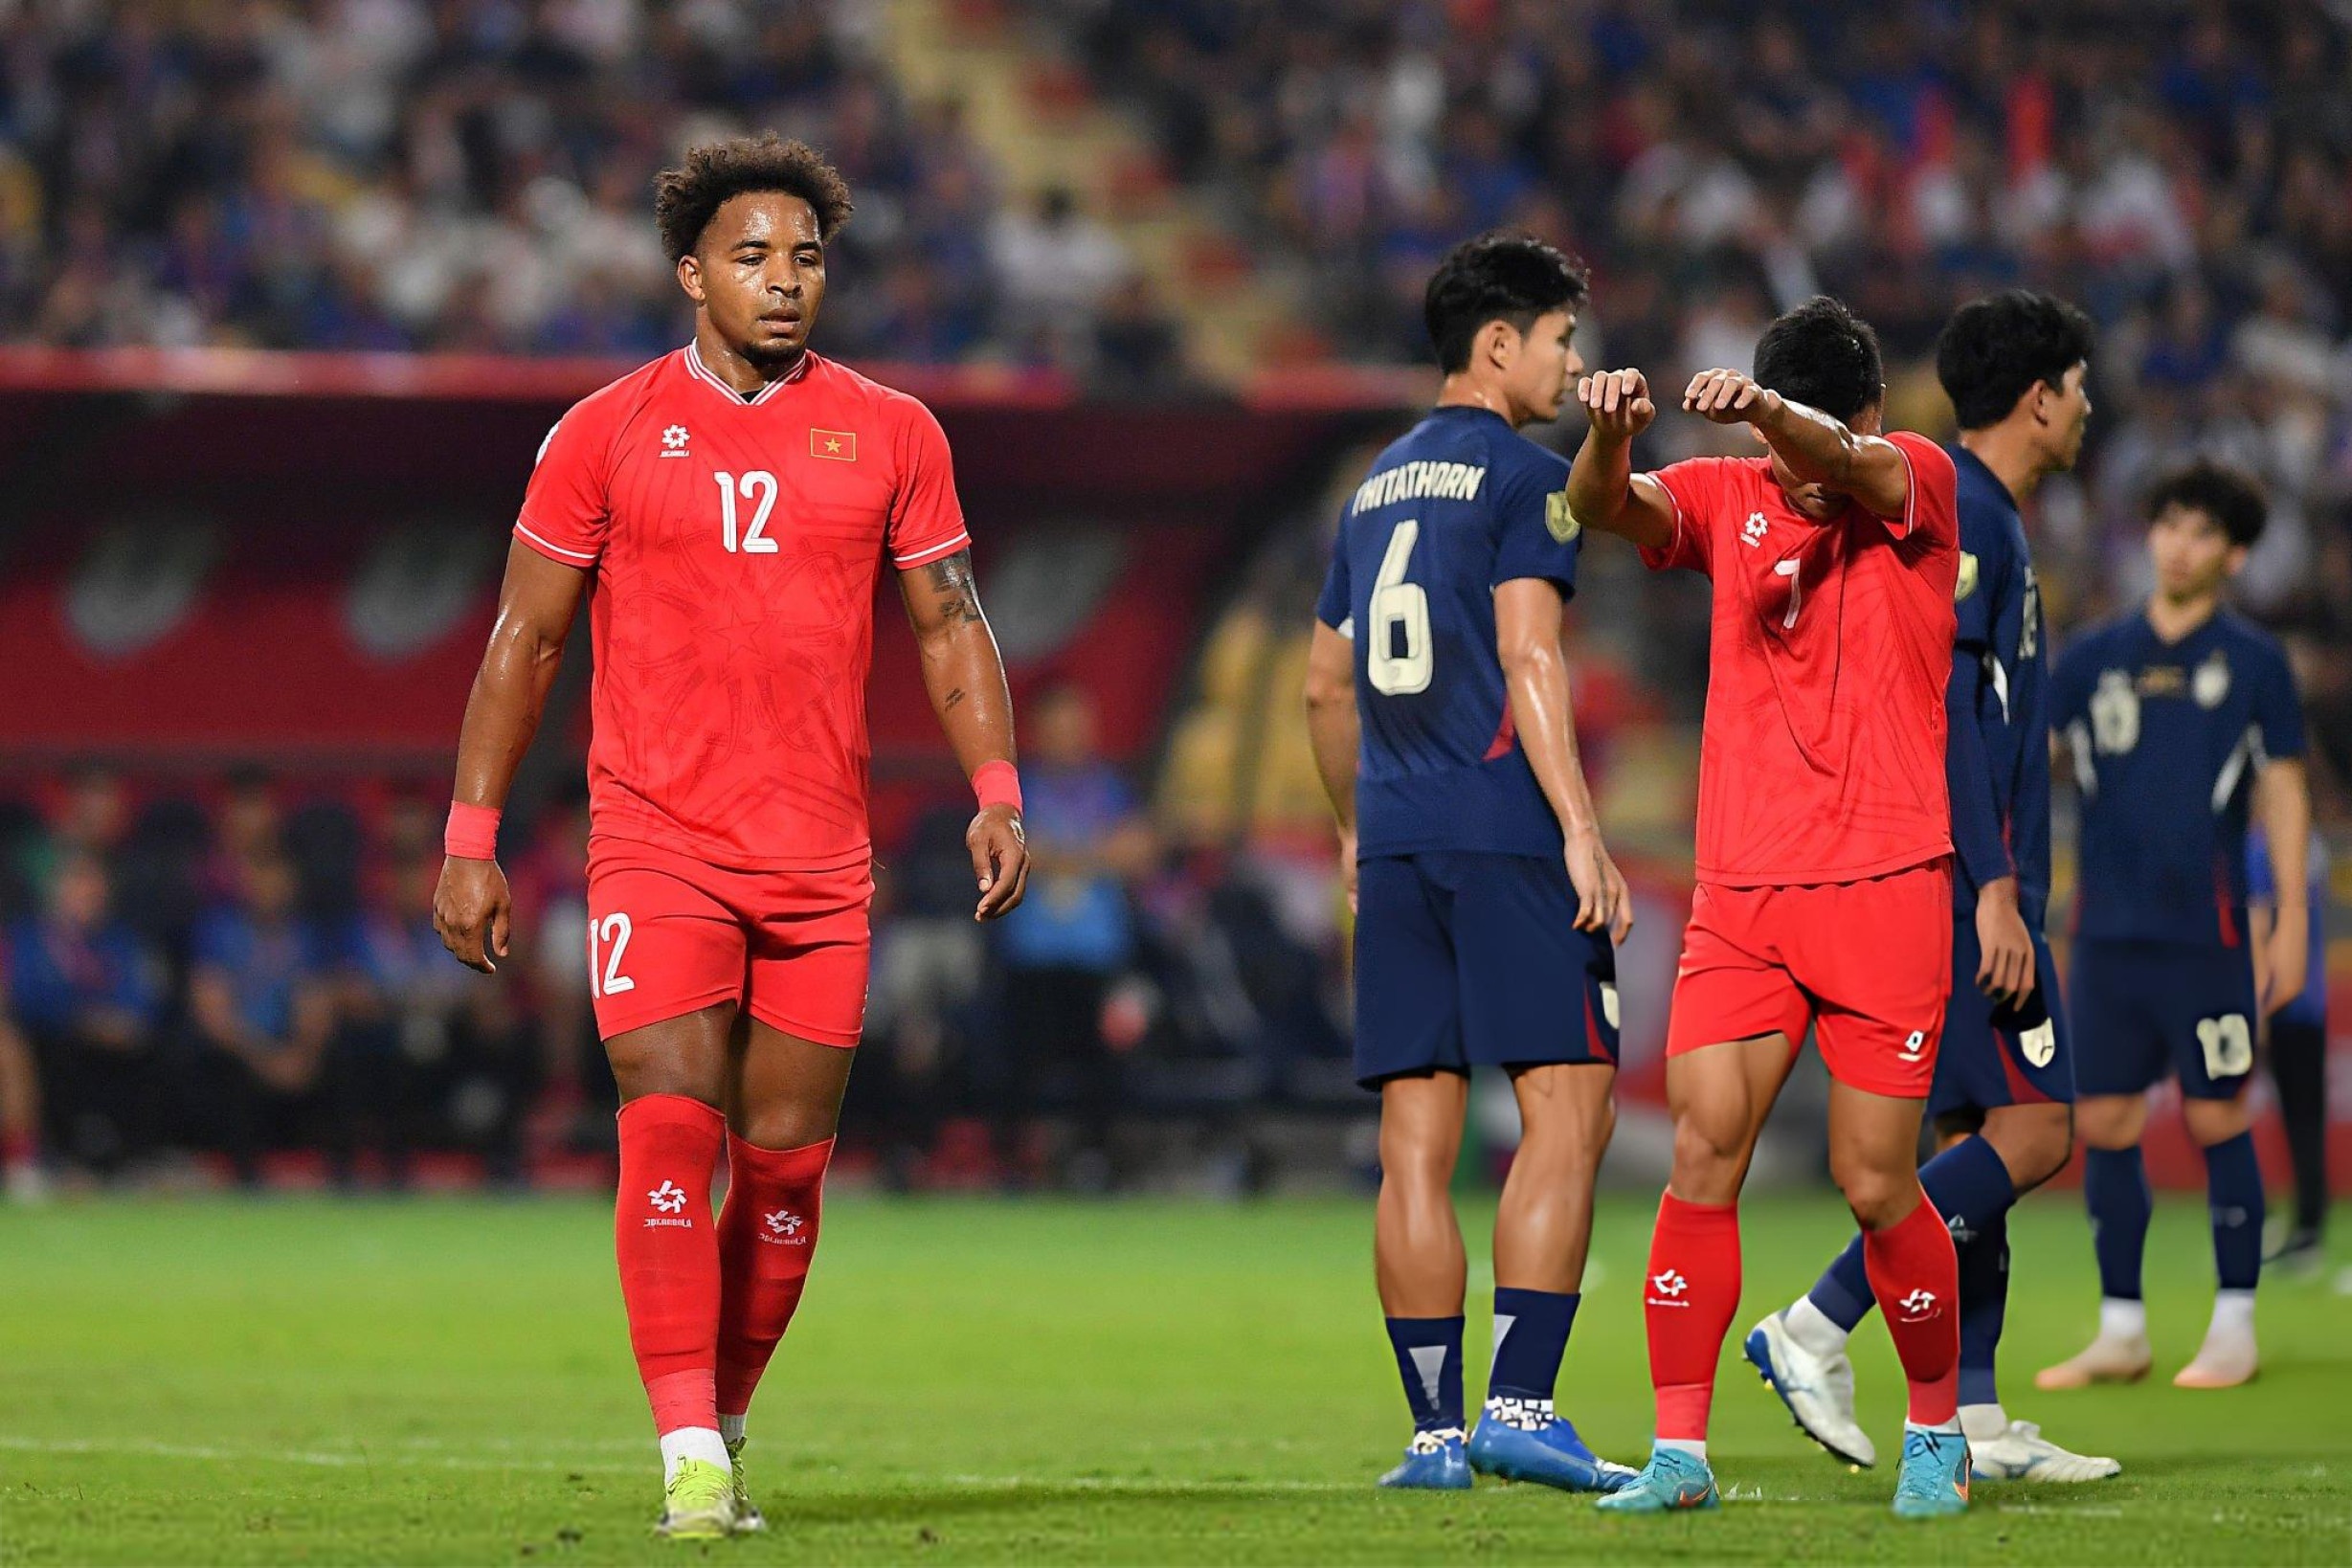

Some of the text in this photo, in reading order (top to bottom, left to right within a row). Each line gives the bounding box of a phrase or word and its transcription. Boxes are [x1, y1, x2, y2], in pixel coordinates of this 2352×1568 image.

[713, 470, 779, 553] 12
[1368, 519, 1434, 696] 6
[1774, 559, 1801, 629] 7
[590, 912, 636, 999] 12
